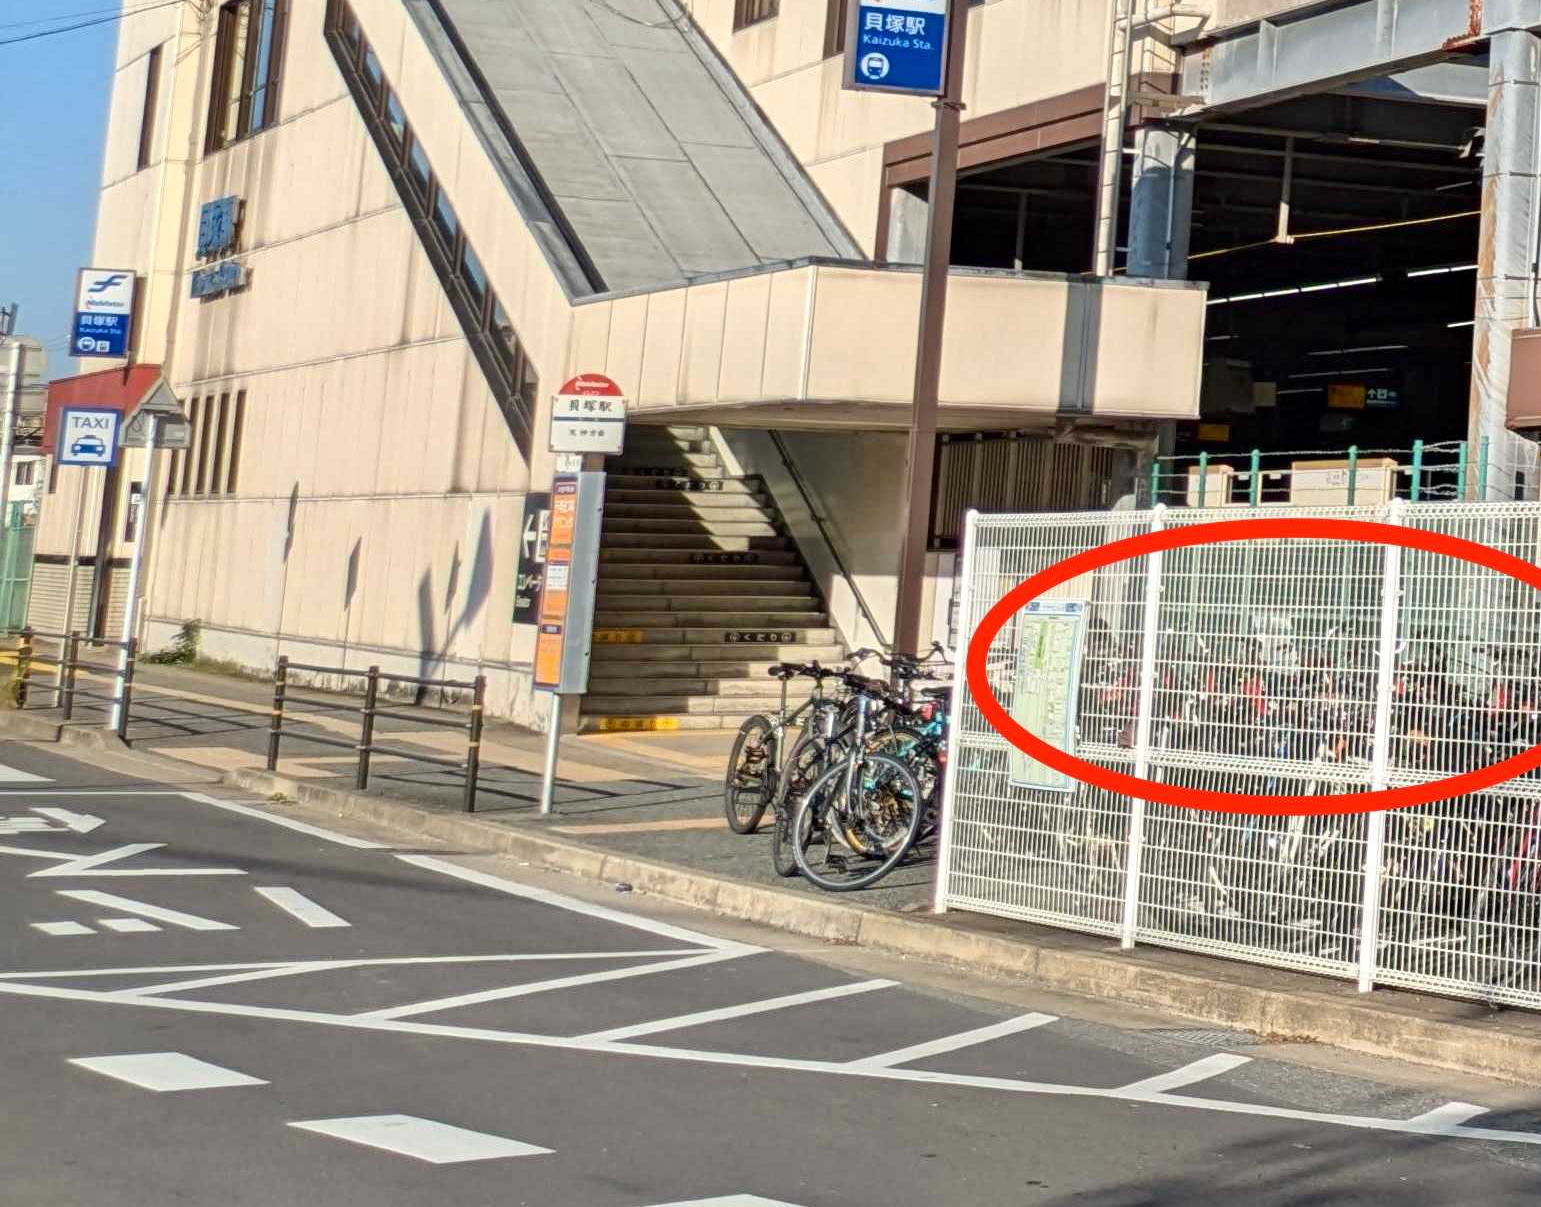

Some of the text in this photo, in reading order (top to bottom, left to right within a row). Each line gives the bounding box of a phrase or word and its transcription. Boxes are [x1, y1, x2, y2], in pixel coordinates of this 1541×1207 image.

[864, 12, 926, 35] 貝塚駅
[863, 34, 935, 50] Kaizuka Sta.
[72, 416, 109, 429] TAXI
